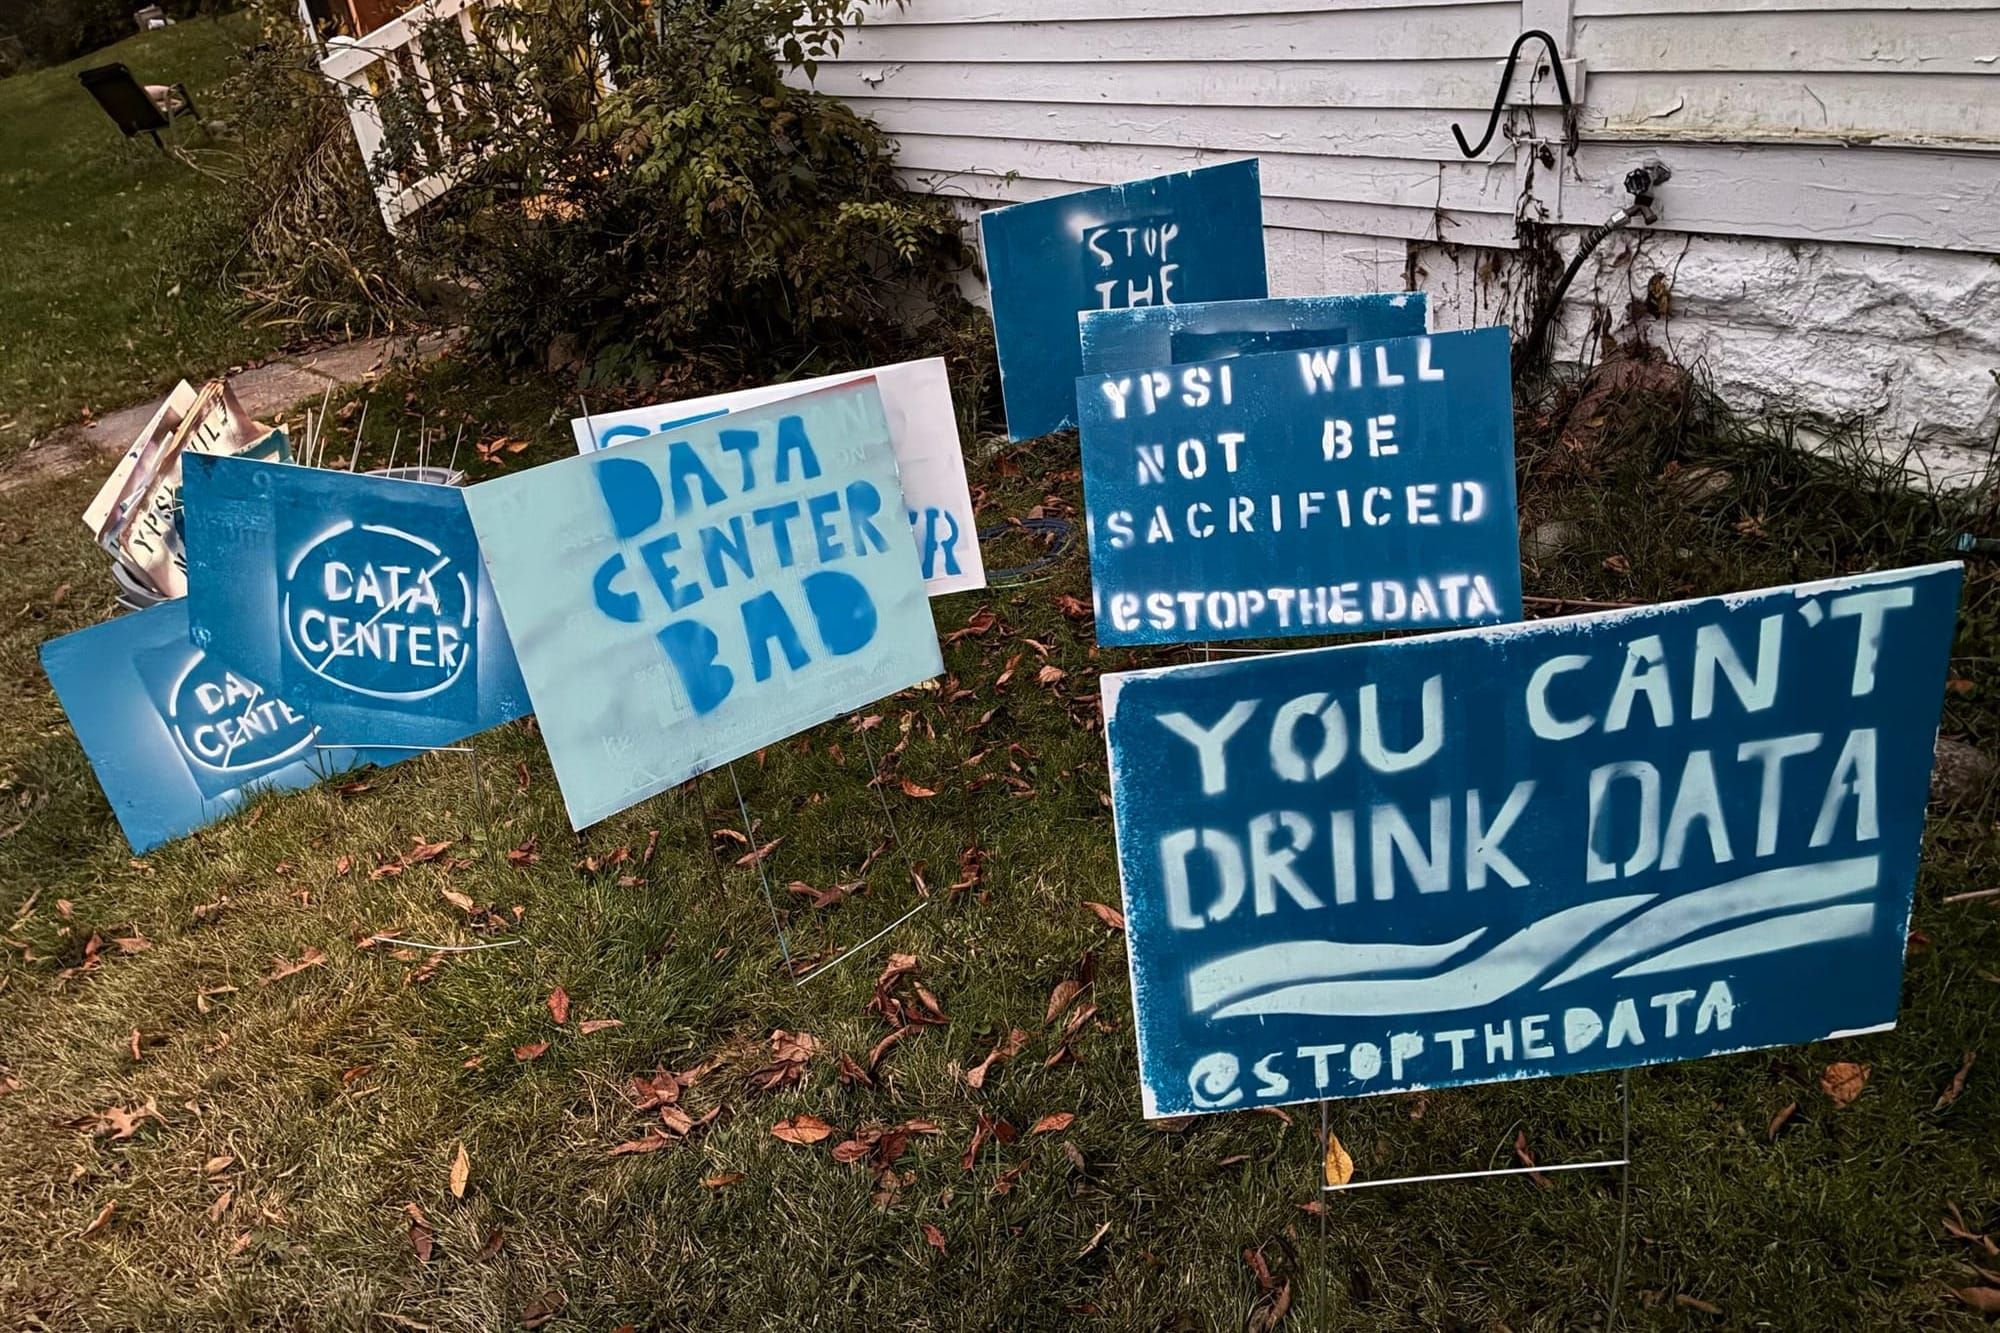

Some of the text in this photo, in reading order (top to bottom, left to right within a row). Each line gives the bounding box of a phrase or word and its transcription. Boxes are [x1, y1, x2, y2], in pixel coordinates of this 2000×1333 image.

[1089, 223, 1178, 266] STOP
[1094, 264, 1179, 309] THE
[1102, 337, 1444, 419] YPSI WILL
[593, 415, 821, 539] DATA
[1136, 414, 1399, 486] NOT BE
[593, 480, 889, 623] CENTER
[1107, 481, 1483, 549] SACRIFICED
[325, 561, 441, 615] DATA
[300, 609, 461, 667] CENTER
[656, 570, 877, 716] BAD
[1155, 587, 1914, 796] YOU CAN'T
[1160, 729, 1879, 931] DRINK DATA
[1188, 980, 1736, 1108] @STOPTHEDATA
